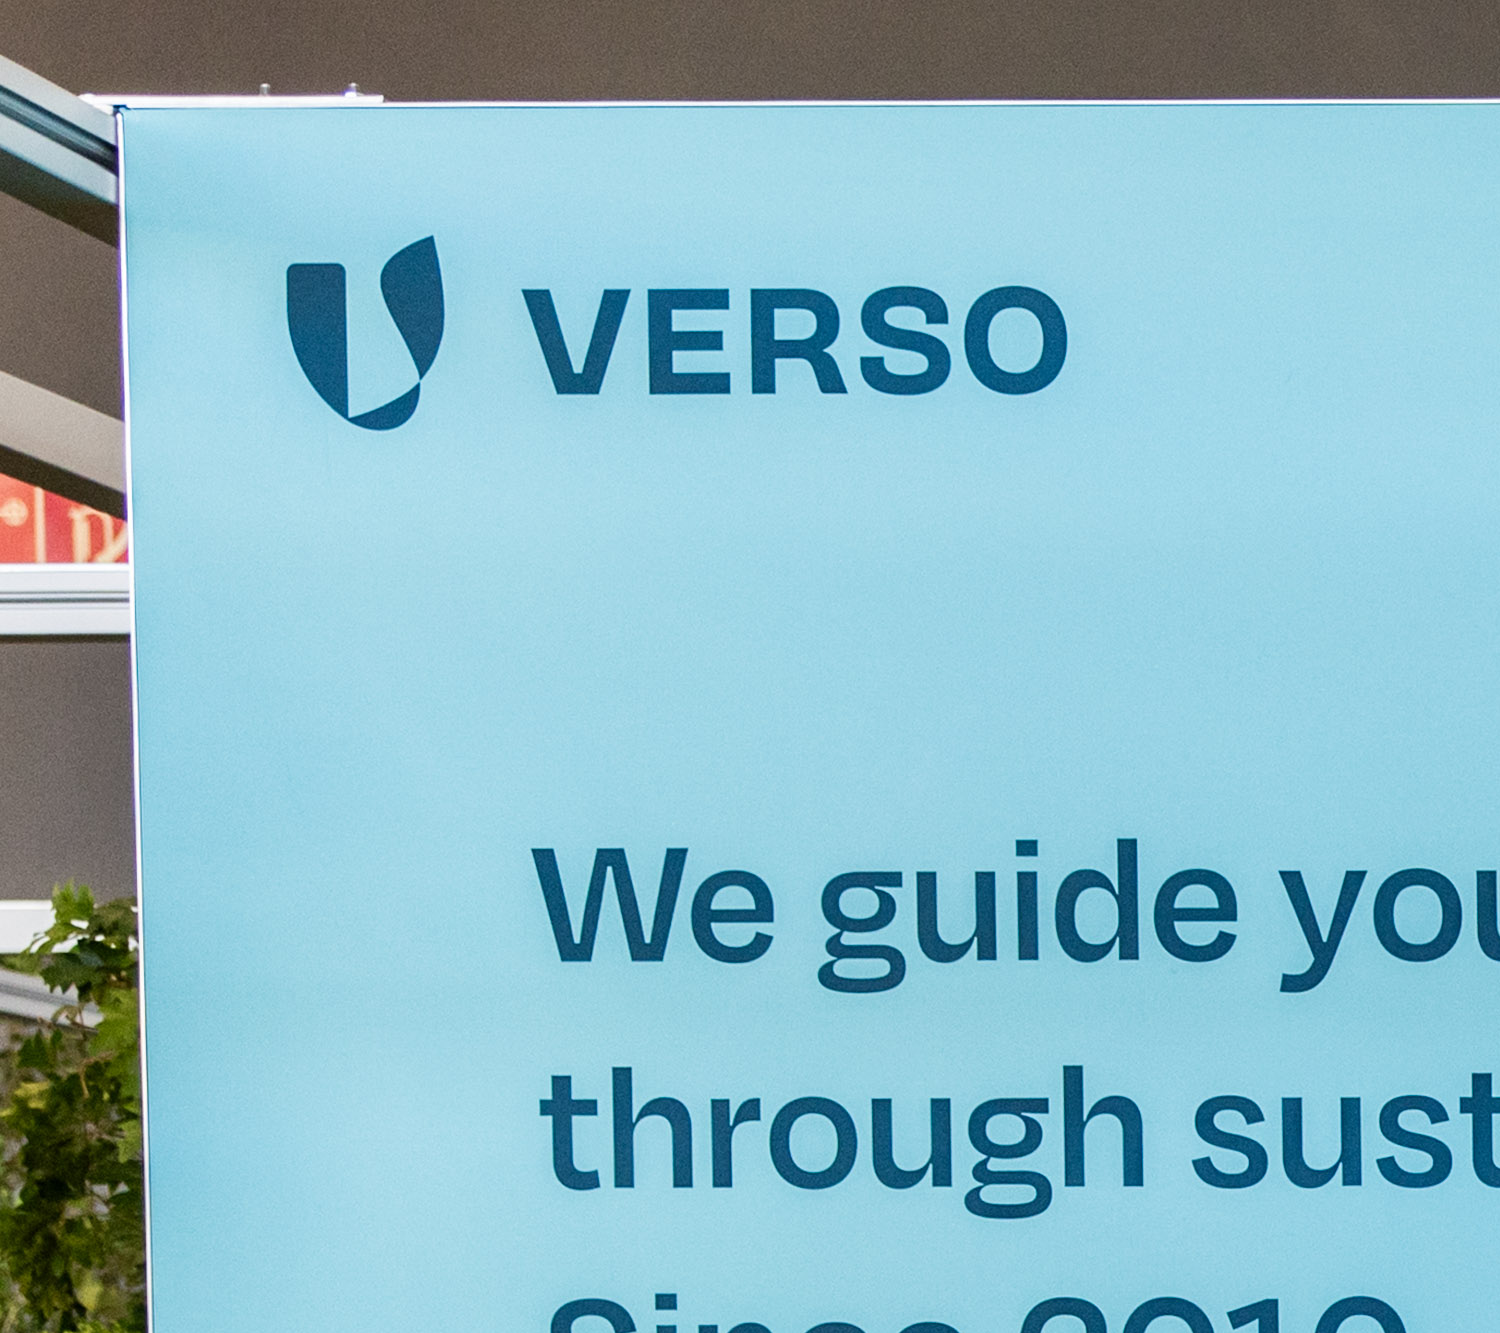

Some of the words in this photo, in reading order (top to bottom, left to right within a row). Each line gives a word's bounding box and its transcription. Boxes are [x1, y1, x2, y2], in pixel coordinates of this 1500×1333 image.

[522, 286, 1067, 395] VERSO
[531, 848, 774, 963] We
[818, 838, 1237, 993] guide
[540, 1065, 1143, 1219] through
